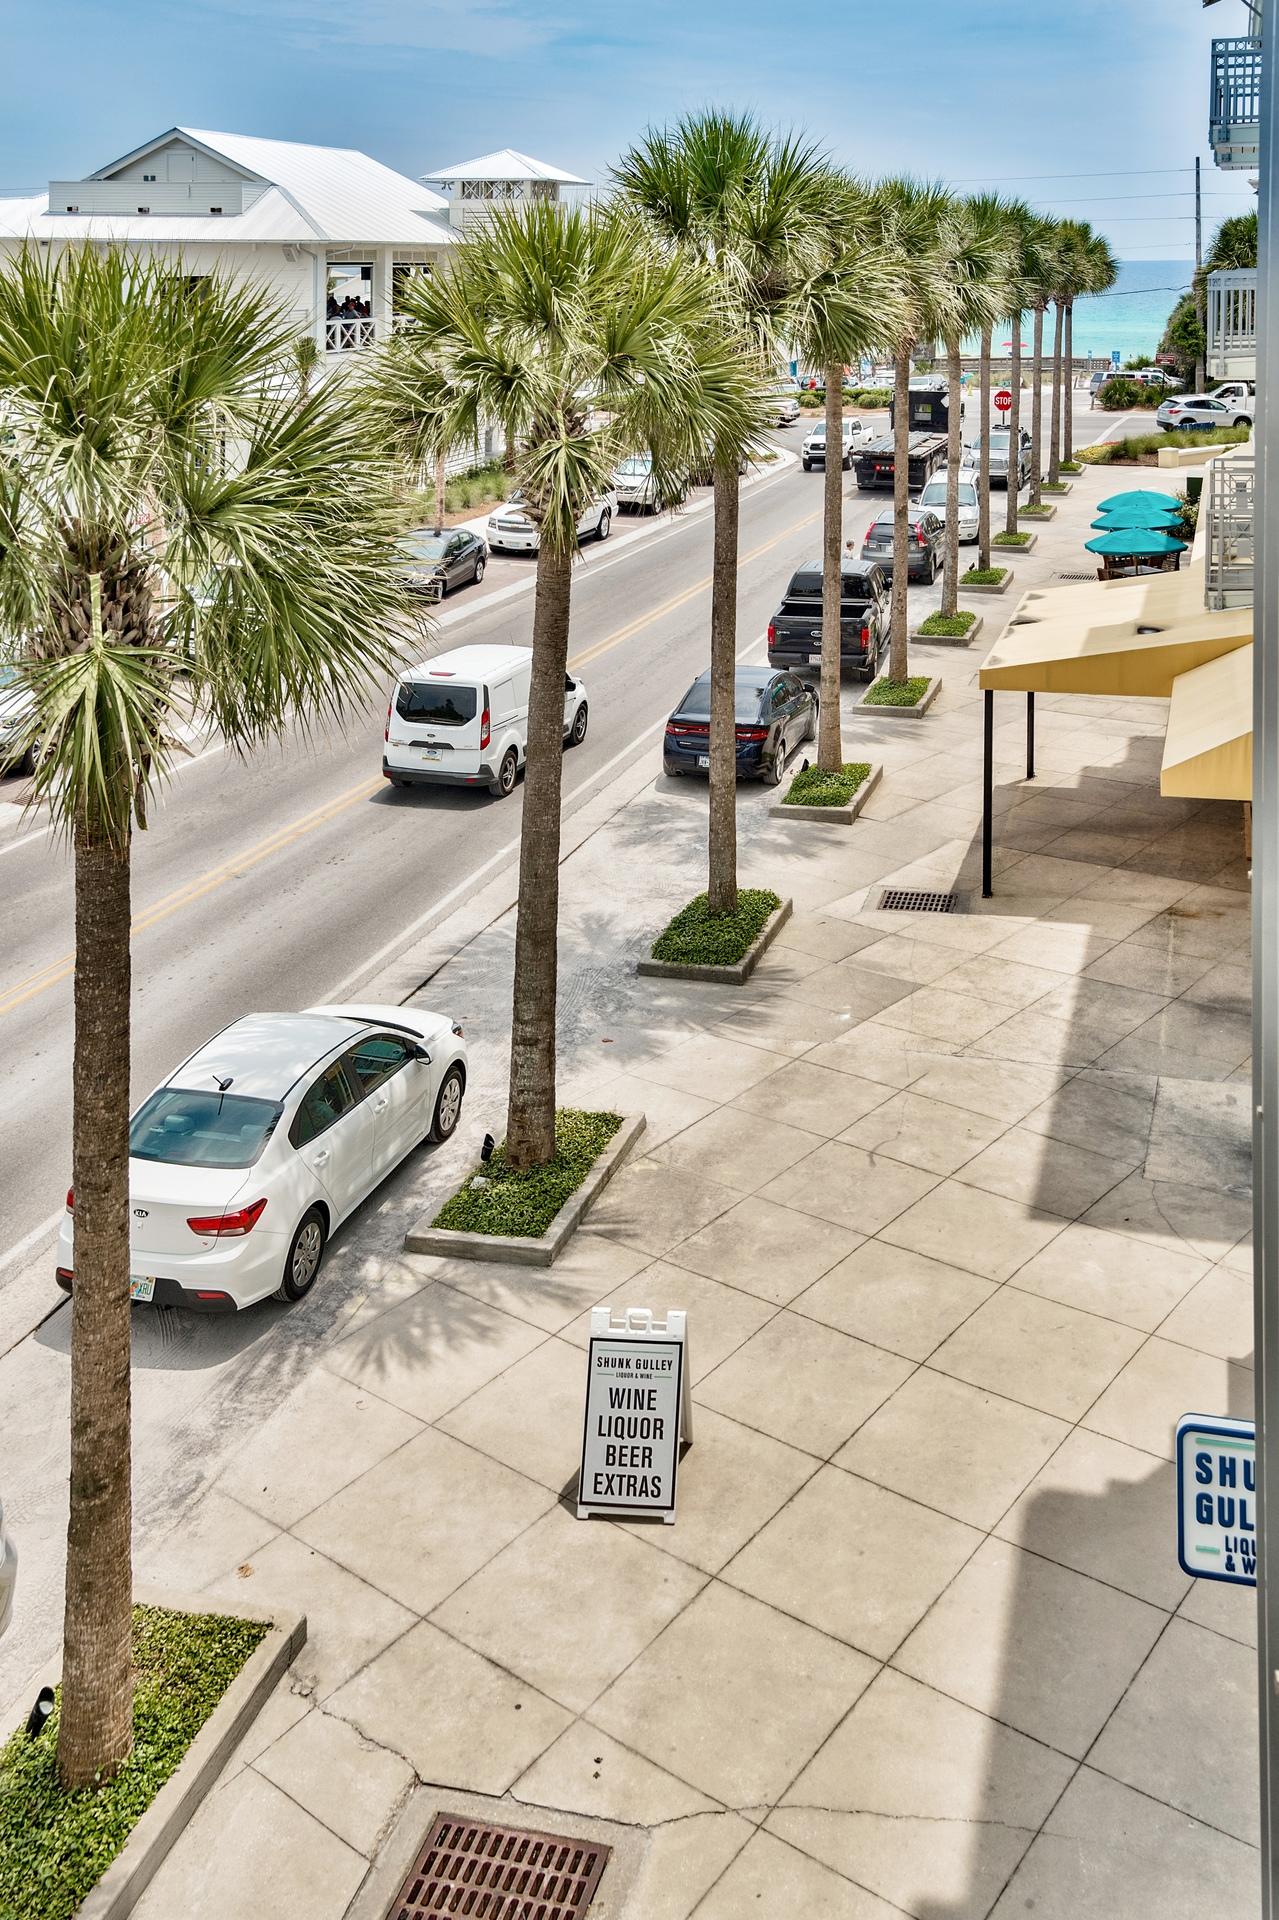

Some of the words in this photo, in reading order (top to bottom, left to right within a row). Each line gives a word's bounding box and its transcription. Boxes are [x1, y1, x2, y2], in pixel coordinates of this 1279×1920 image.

[597, 1356, 632, 1369] SHUNK
[635, 1358, 673, 1371] GULLEY
[609, 1387, 657, 1411] WINE
[598, 1415, 664, 1440] LIQUOR
[605, 1444, 653, 1468] BEER
[593, 1472, 662, 1498] EXTRAS
[1225, 1554, 1236, 1573] &
